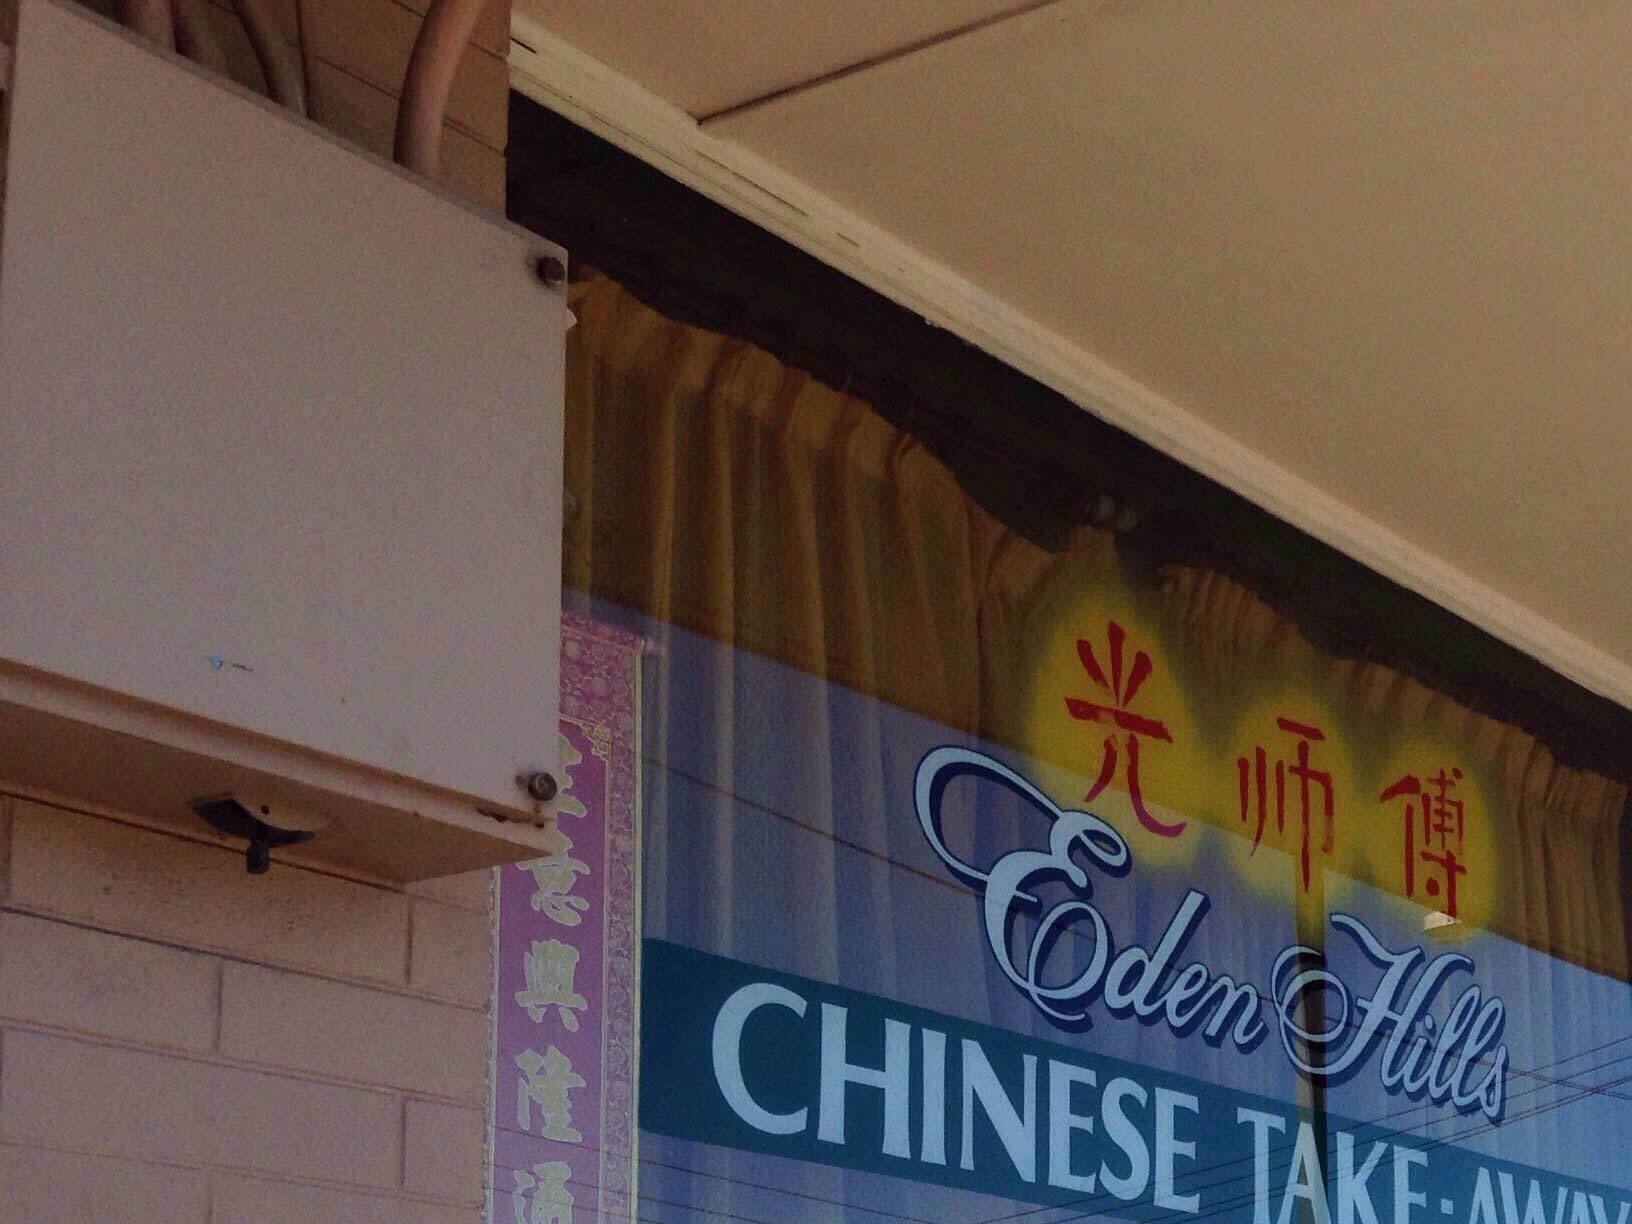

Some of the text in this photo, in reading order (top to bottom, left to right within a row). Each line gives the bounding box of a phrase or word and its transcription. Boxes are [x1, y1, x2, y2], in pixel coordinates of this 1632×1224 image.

[912, 743, 1510, 1125] Eden Hills
[710, 980, 1201, 1215] CHINESE
